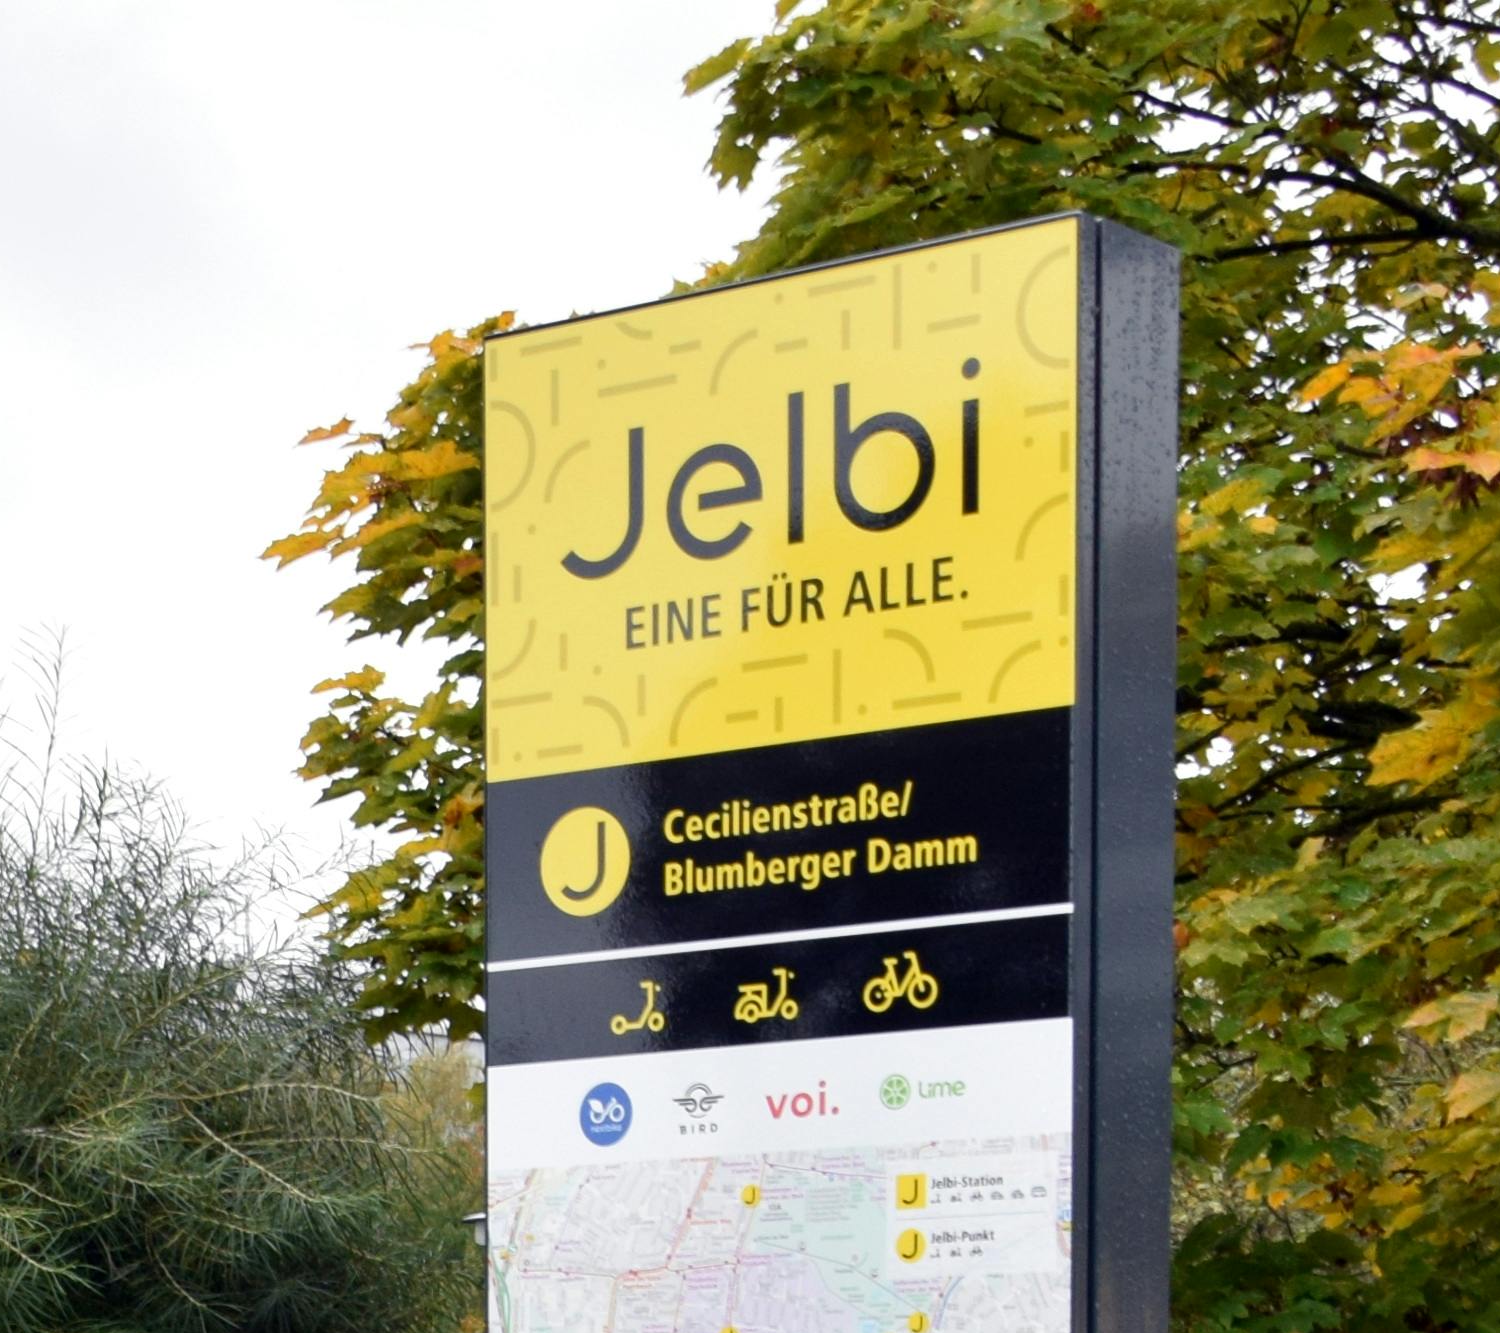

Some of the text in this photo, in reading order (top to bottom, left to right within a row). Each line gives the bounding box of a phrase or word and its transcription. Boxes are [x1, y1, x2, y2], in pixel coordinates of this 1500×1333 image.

[560, 357, 981, 580] Jelbi
[626, 556, 969, 650] EINE FÜR ALLE.
[663, 780, 913, 844] Cecilienstraße/
[663, 836, 978, 896] Blumberger Damm
[766, 1080, 840, 1119] voi.
[679, 1123, 719, 1135] BIRD
[930, 1174, 1004, 1190] Jelbi-Station
[930, 1229, 995, 1245] Jelbi-Punkt
